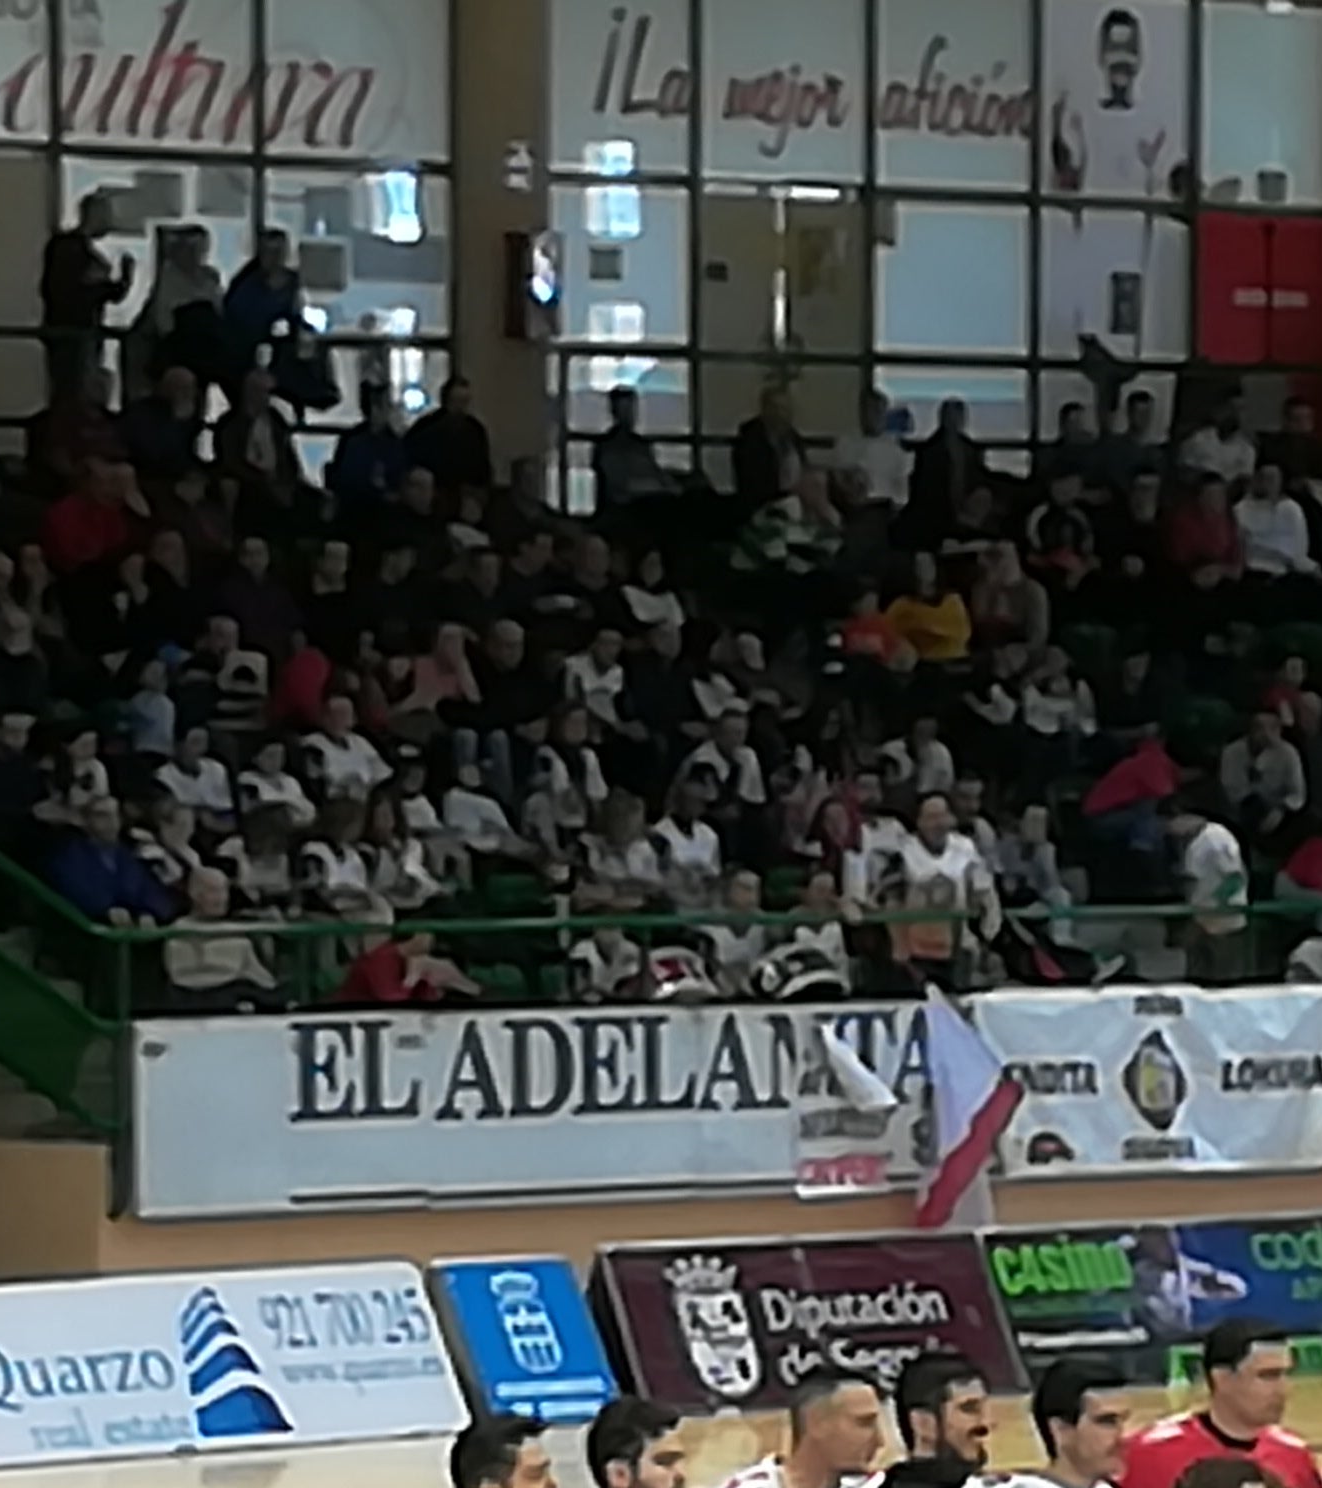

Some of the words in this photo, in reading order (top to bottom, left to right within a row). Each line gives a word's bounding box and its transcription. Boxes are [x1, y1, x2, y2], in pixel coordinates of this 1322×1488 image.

[723, 62, 849, 158] mejor
[879, 33, 1034, 138] afición
[289, 1020, 422, 1122] EL
[436, 1008, 936, 1120] ADELANTA
[760, 1281, 950, 1340] Diputación
